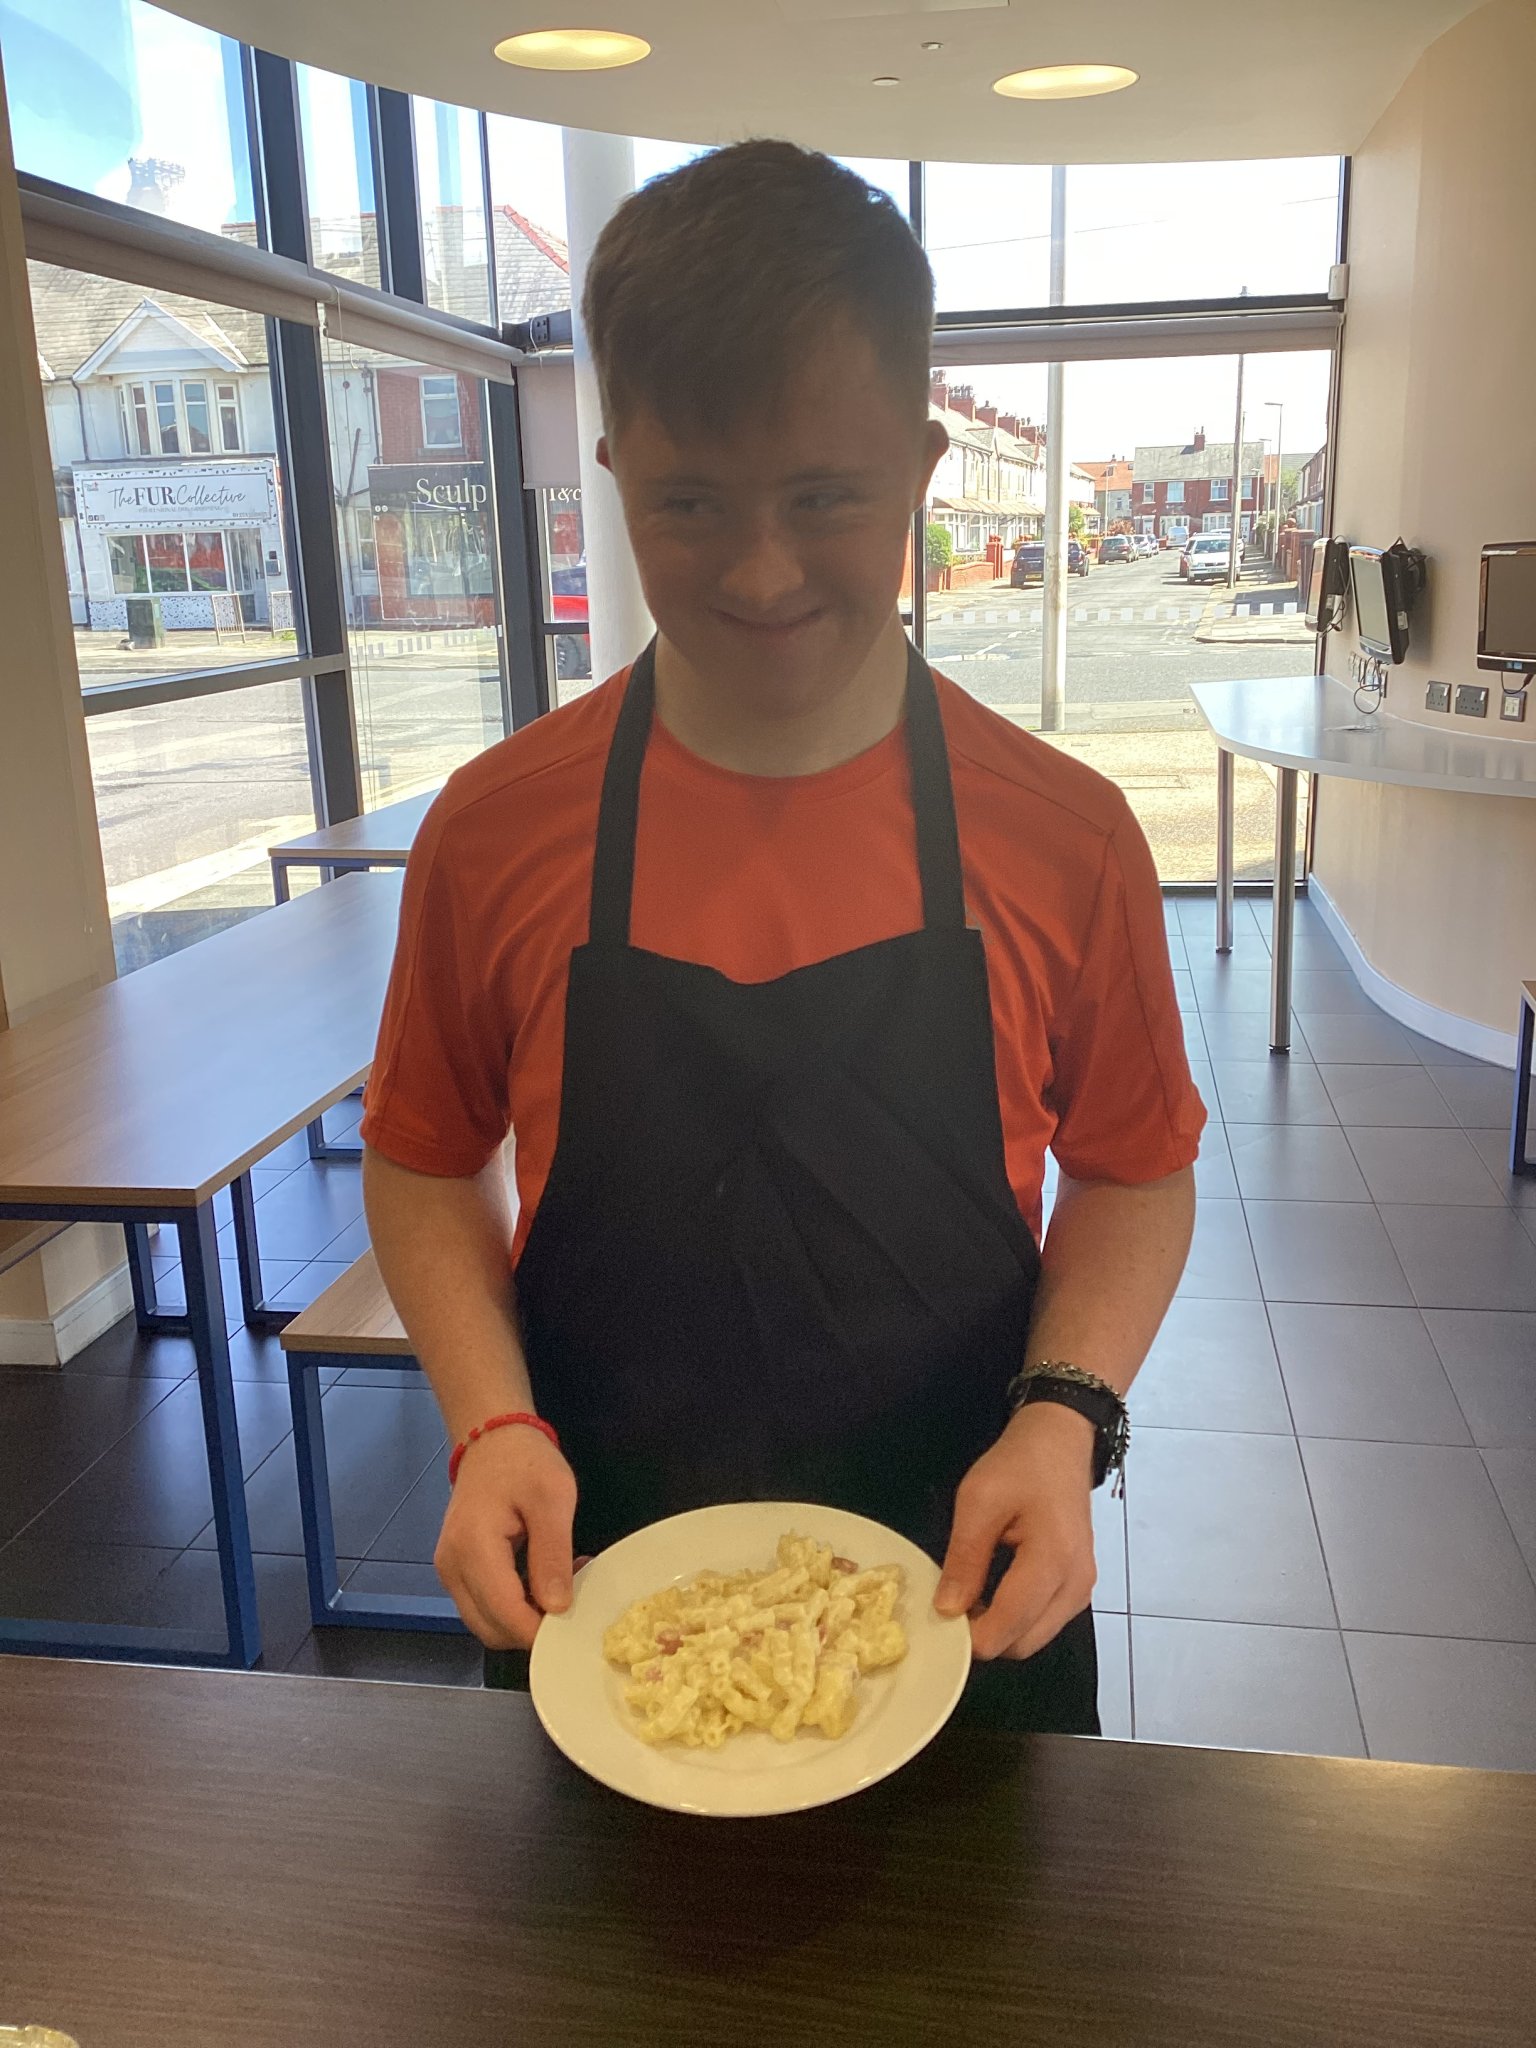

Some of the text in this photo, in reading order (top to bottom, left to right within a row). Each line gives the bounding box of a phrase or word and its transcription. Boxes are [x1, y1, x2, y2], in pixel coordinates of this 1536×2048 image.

[107, 486, 135, 509] The
[134, 486, 176, 506] FUR
[176, 484, 246, 506] Collective
[416, 478, 487, 512] Sculp
